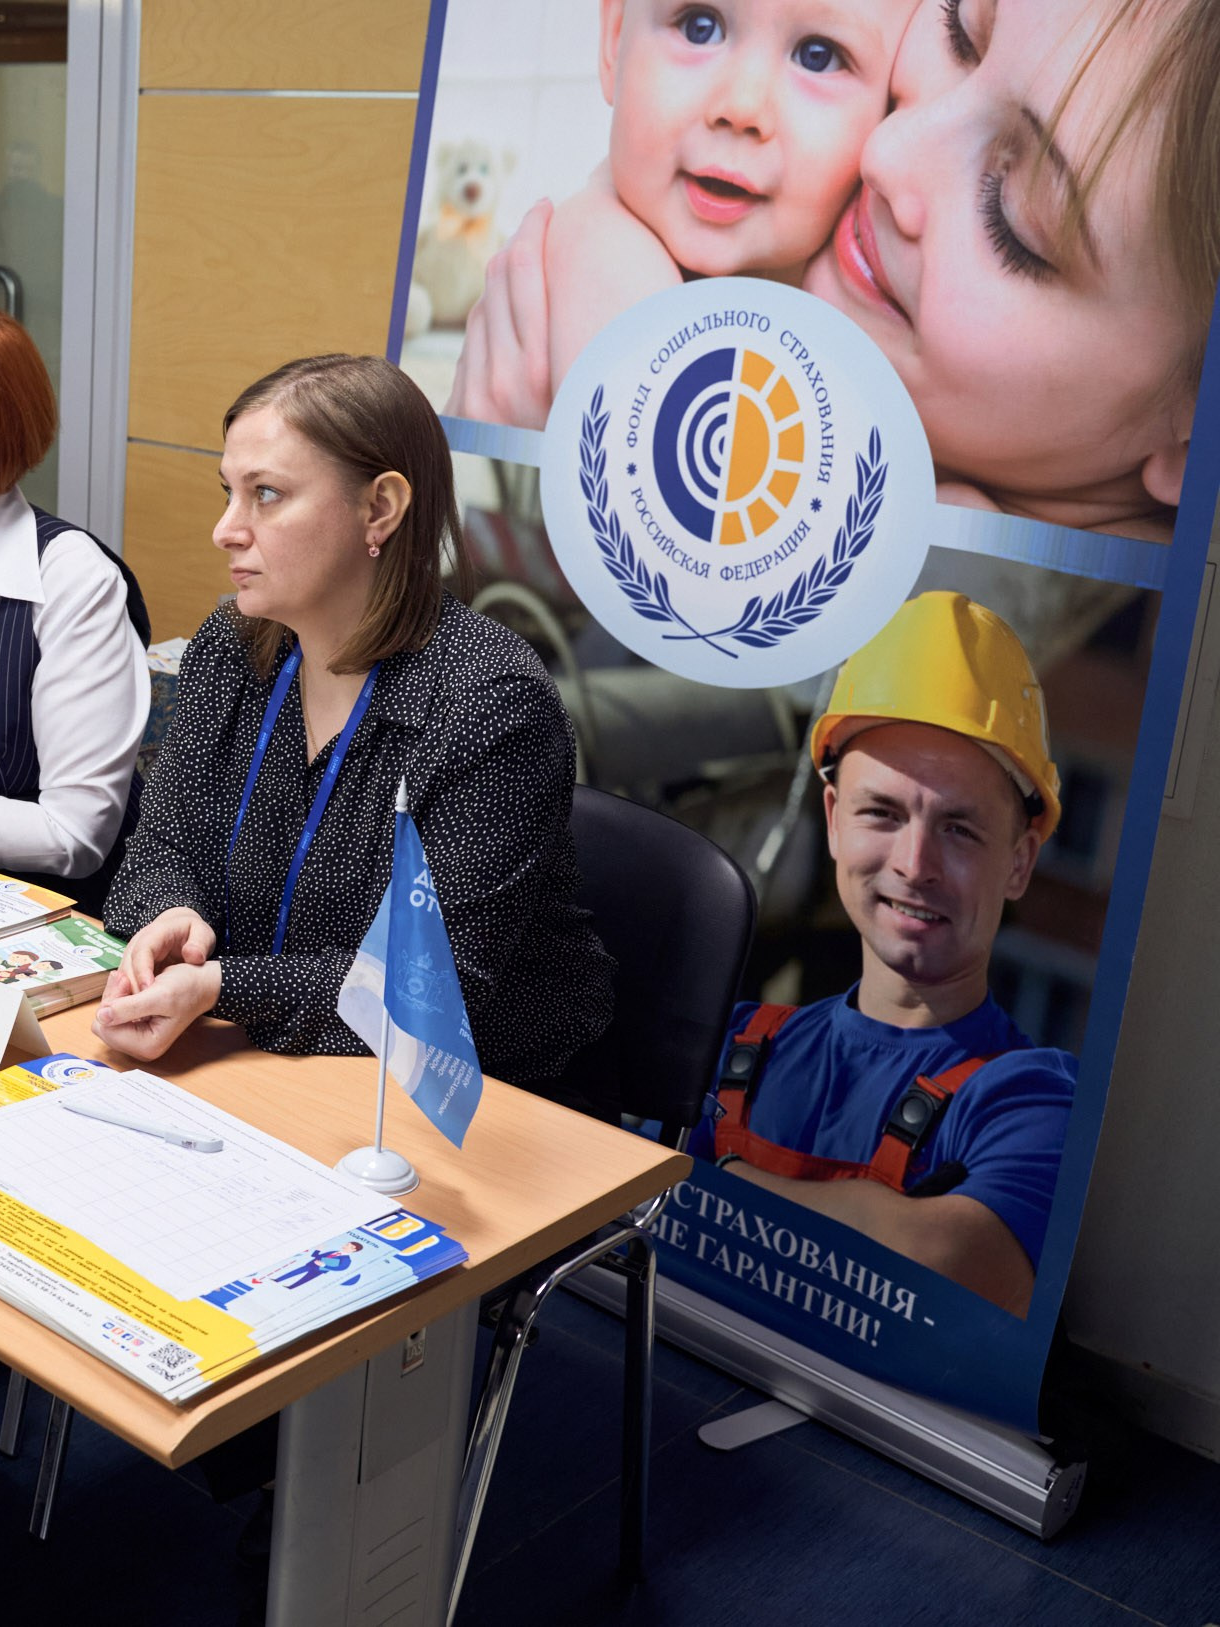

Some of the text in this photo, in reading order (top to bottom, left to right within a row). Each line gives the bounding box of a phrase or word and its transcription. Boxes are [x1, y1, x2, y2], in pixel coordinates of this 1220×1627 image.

[626, 310, 834, 484] ФОНД СОЦИАЛЬНОГО СТРАХОВАНИЯ
[630, 487, 811, 582] РОССИЙСКАЯ ФЕДЕРАЦИЯ
[673, 1181, 918, 1321] СТРАХОВАНИЯ
[697, 1232, 880, 1348] ГАРАНТИИ!
